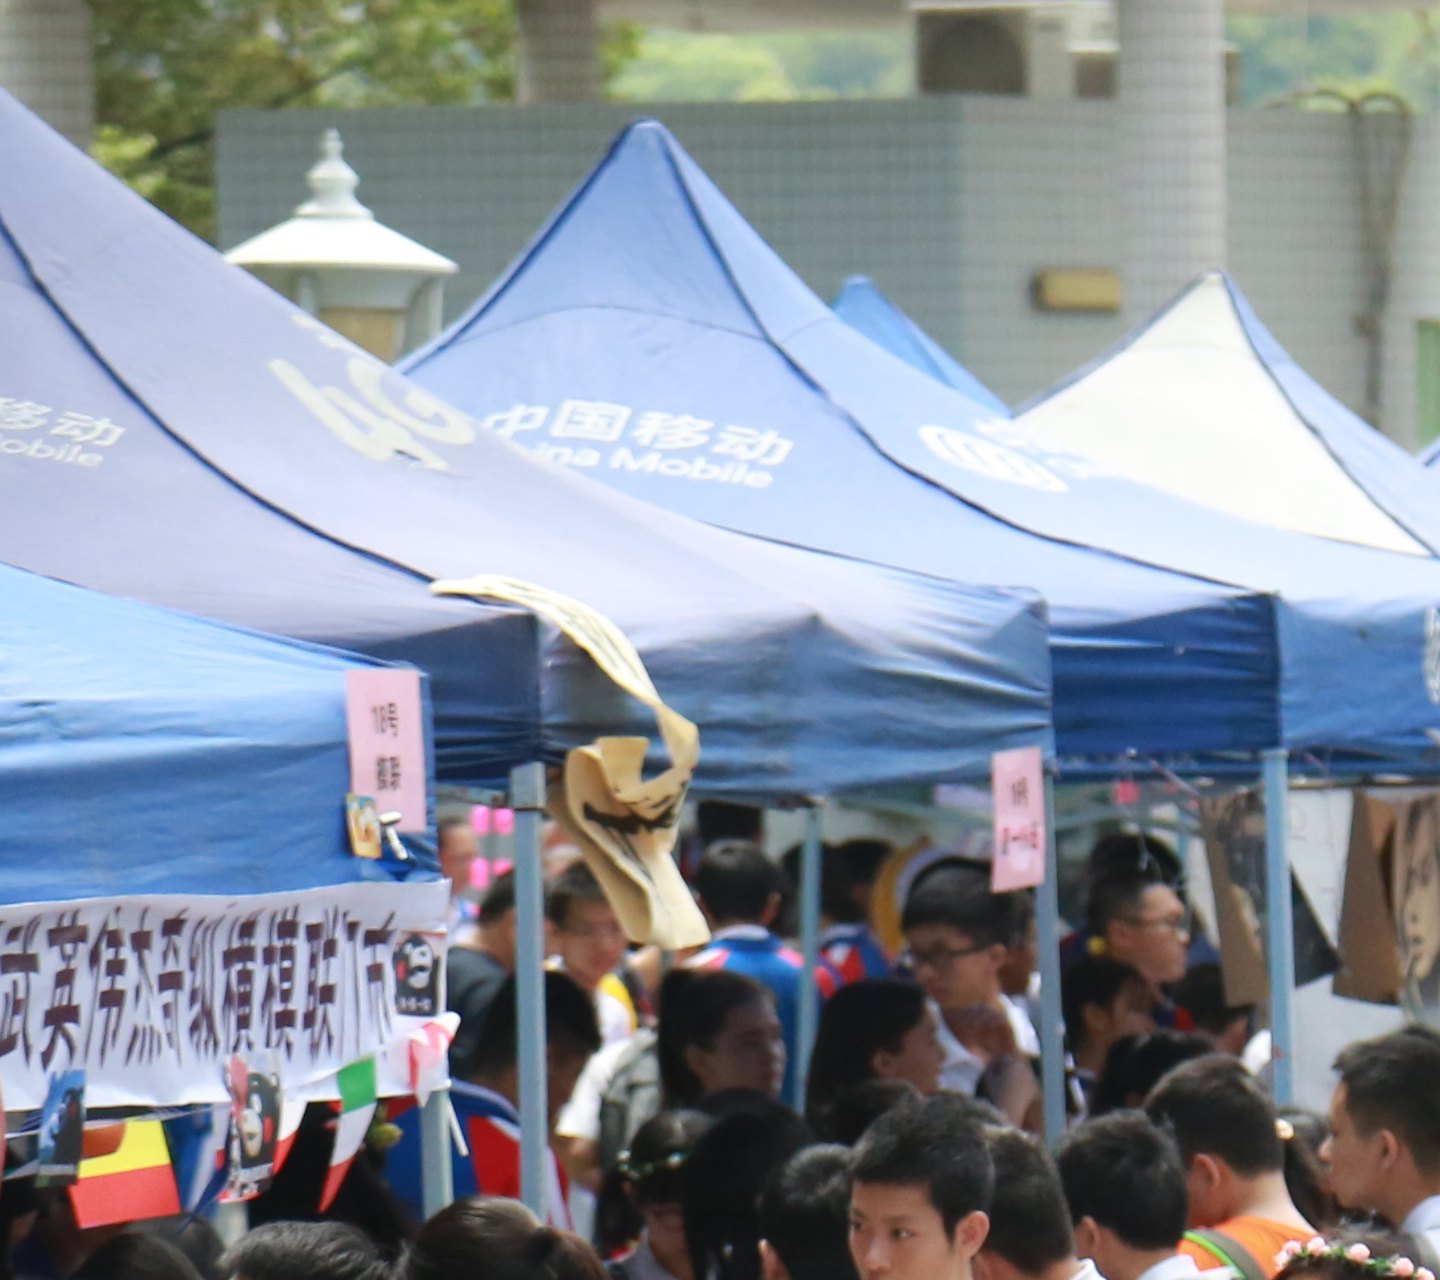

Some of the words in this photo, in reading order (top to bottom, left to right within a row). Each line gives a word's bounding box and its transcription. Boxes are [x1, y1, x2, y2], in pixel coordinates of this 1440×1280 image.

[483, 398, 795, 467] 中国移动
[534, 442, 602, 469] ina
[608, 447, 775, 489] Mobile
